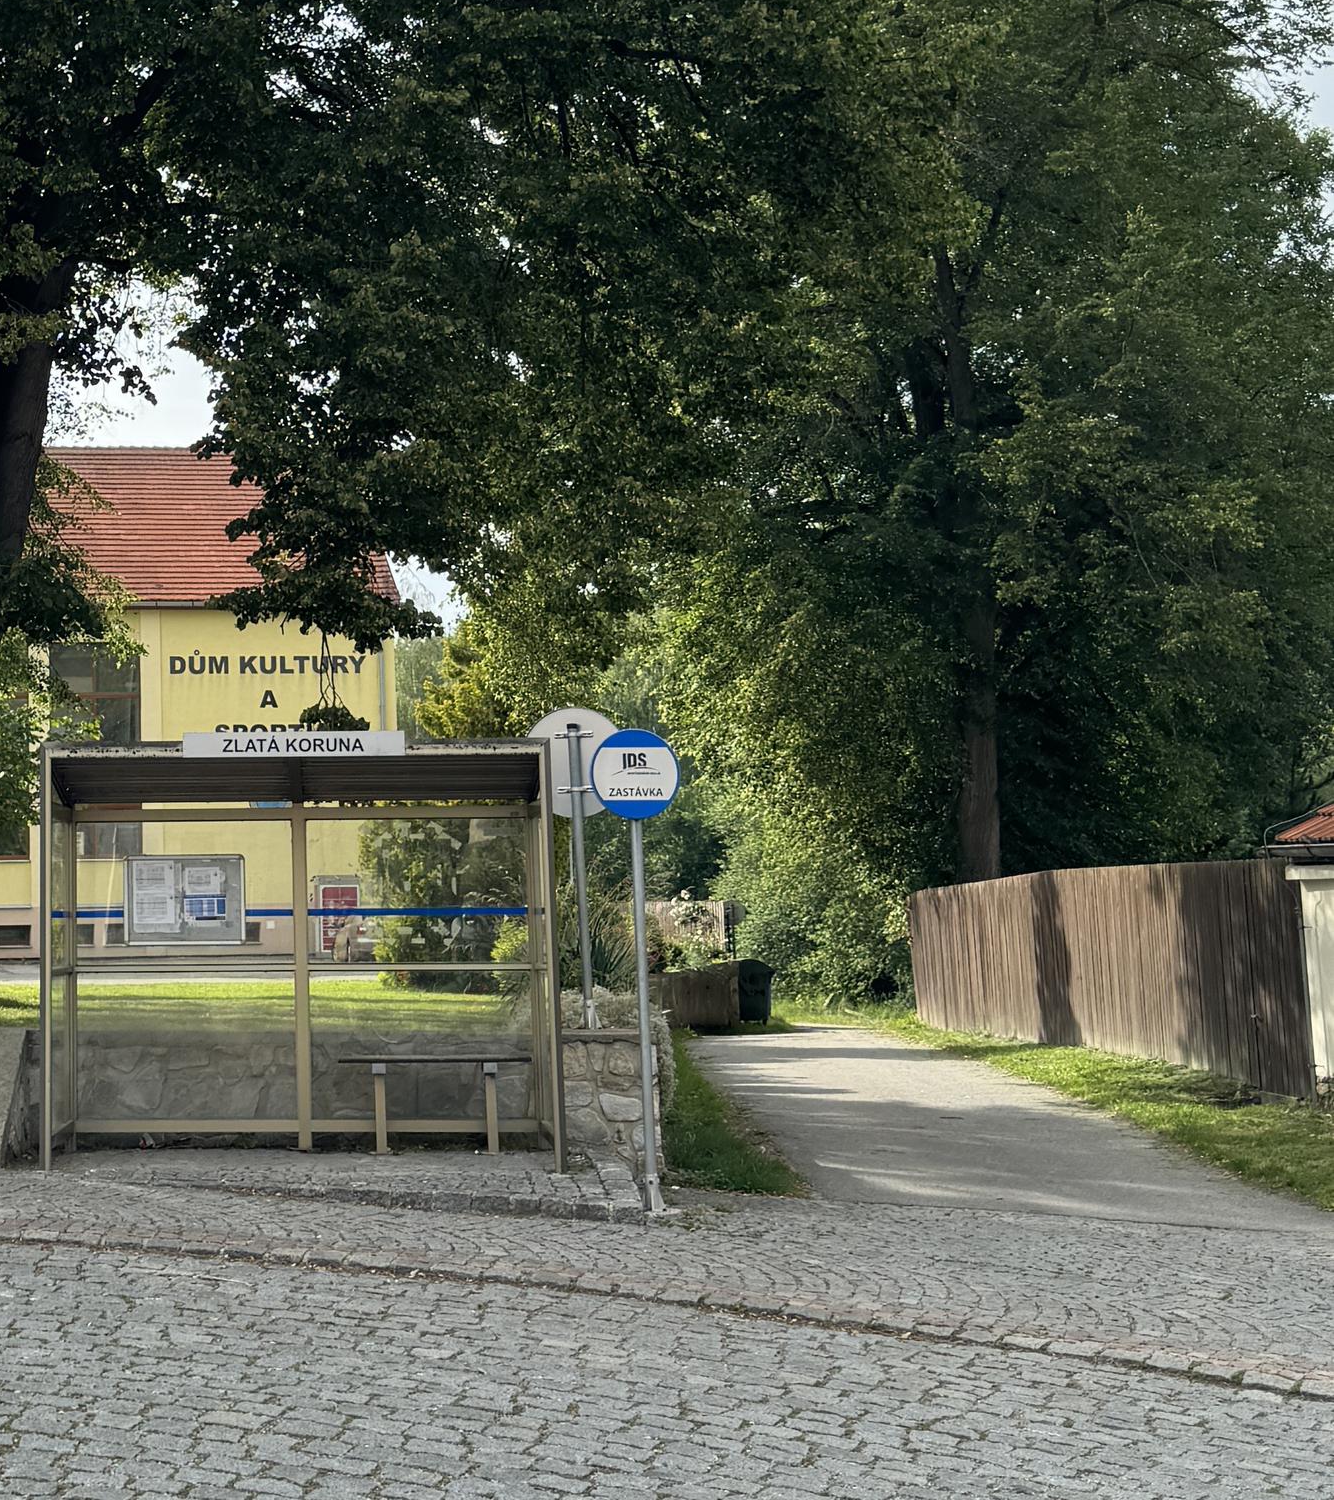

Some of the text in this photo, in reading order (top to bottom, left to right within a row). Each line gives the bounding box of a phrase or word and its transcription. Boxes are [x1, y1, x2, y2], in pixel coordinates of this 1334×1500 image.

[169, 649, 366, 675] DŮM KULTURY
[260, 690, 279, 708] A
[222, 735, 364, 753] ZLATÁ KORUNA
[622, 752, 647, 770] IDS
[609, 786, 664, 797] ZASTÁVKA
